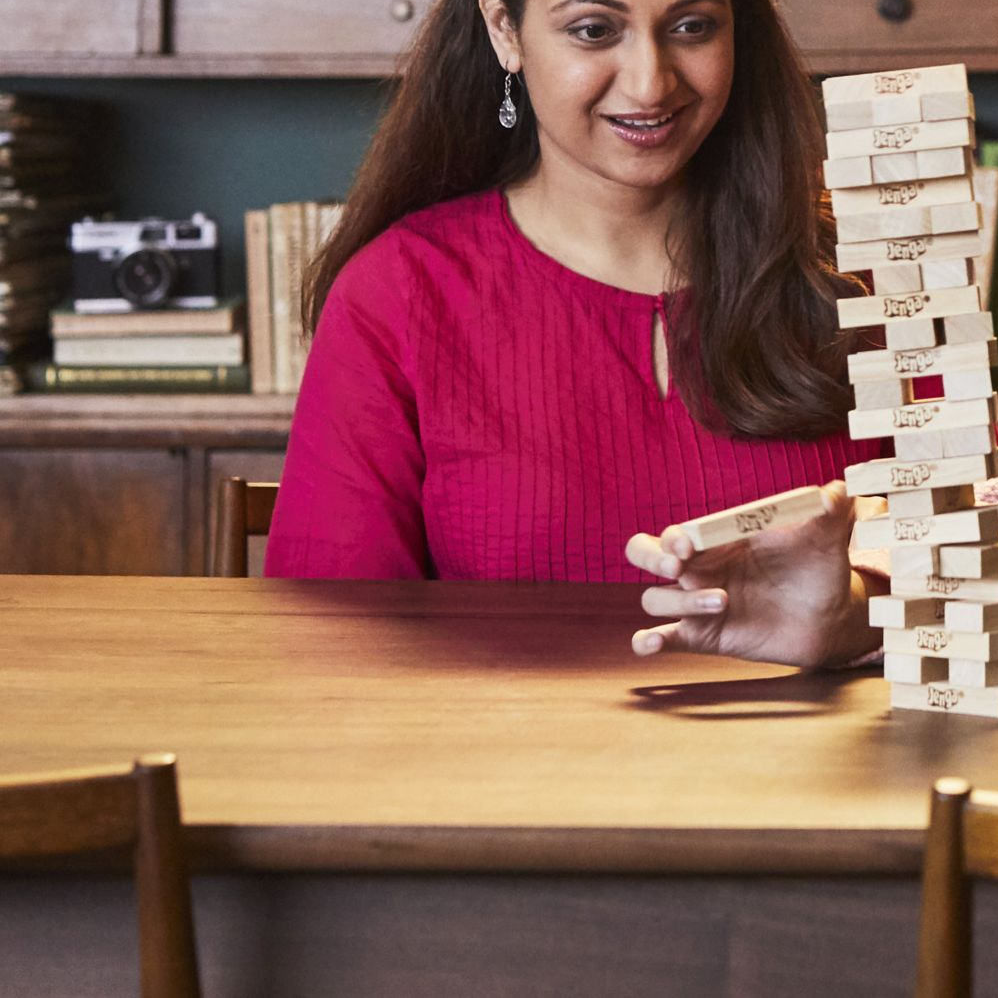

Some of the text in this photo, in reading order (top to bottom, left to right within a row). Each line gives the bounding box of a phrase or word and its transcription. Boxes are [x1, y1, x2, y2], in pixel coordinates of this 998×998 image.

[887, 239, 927, 260] Jenga
[884, 295, 923, 317] Jenga
[894, 350, 934, 373] Jenga
[893, 407, 932, 428] Jenga
[891, 464, 930, 486] Jenga
